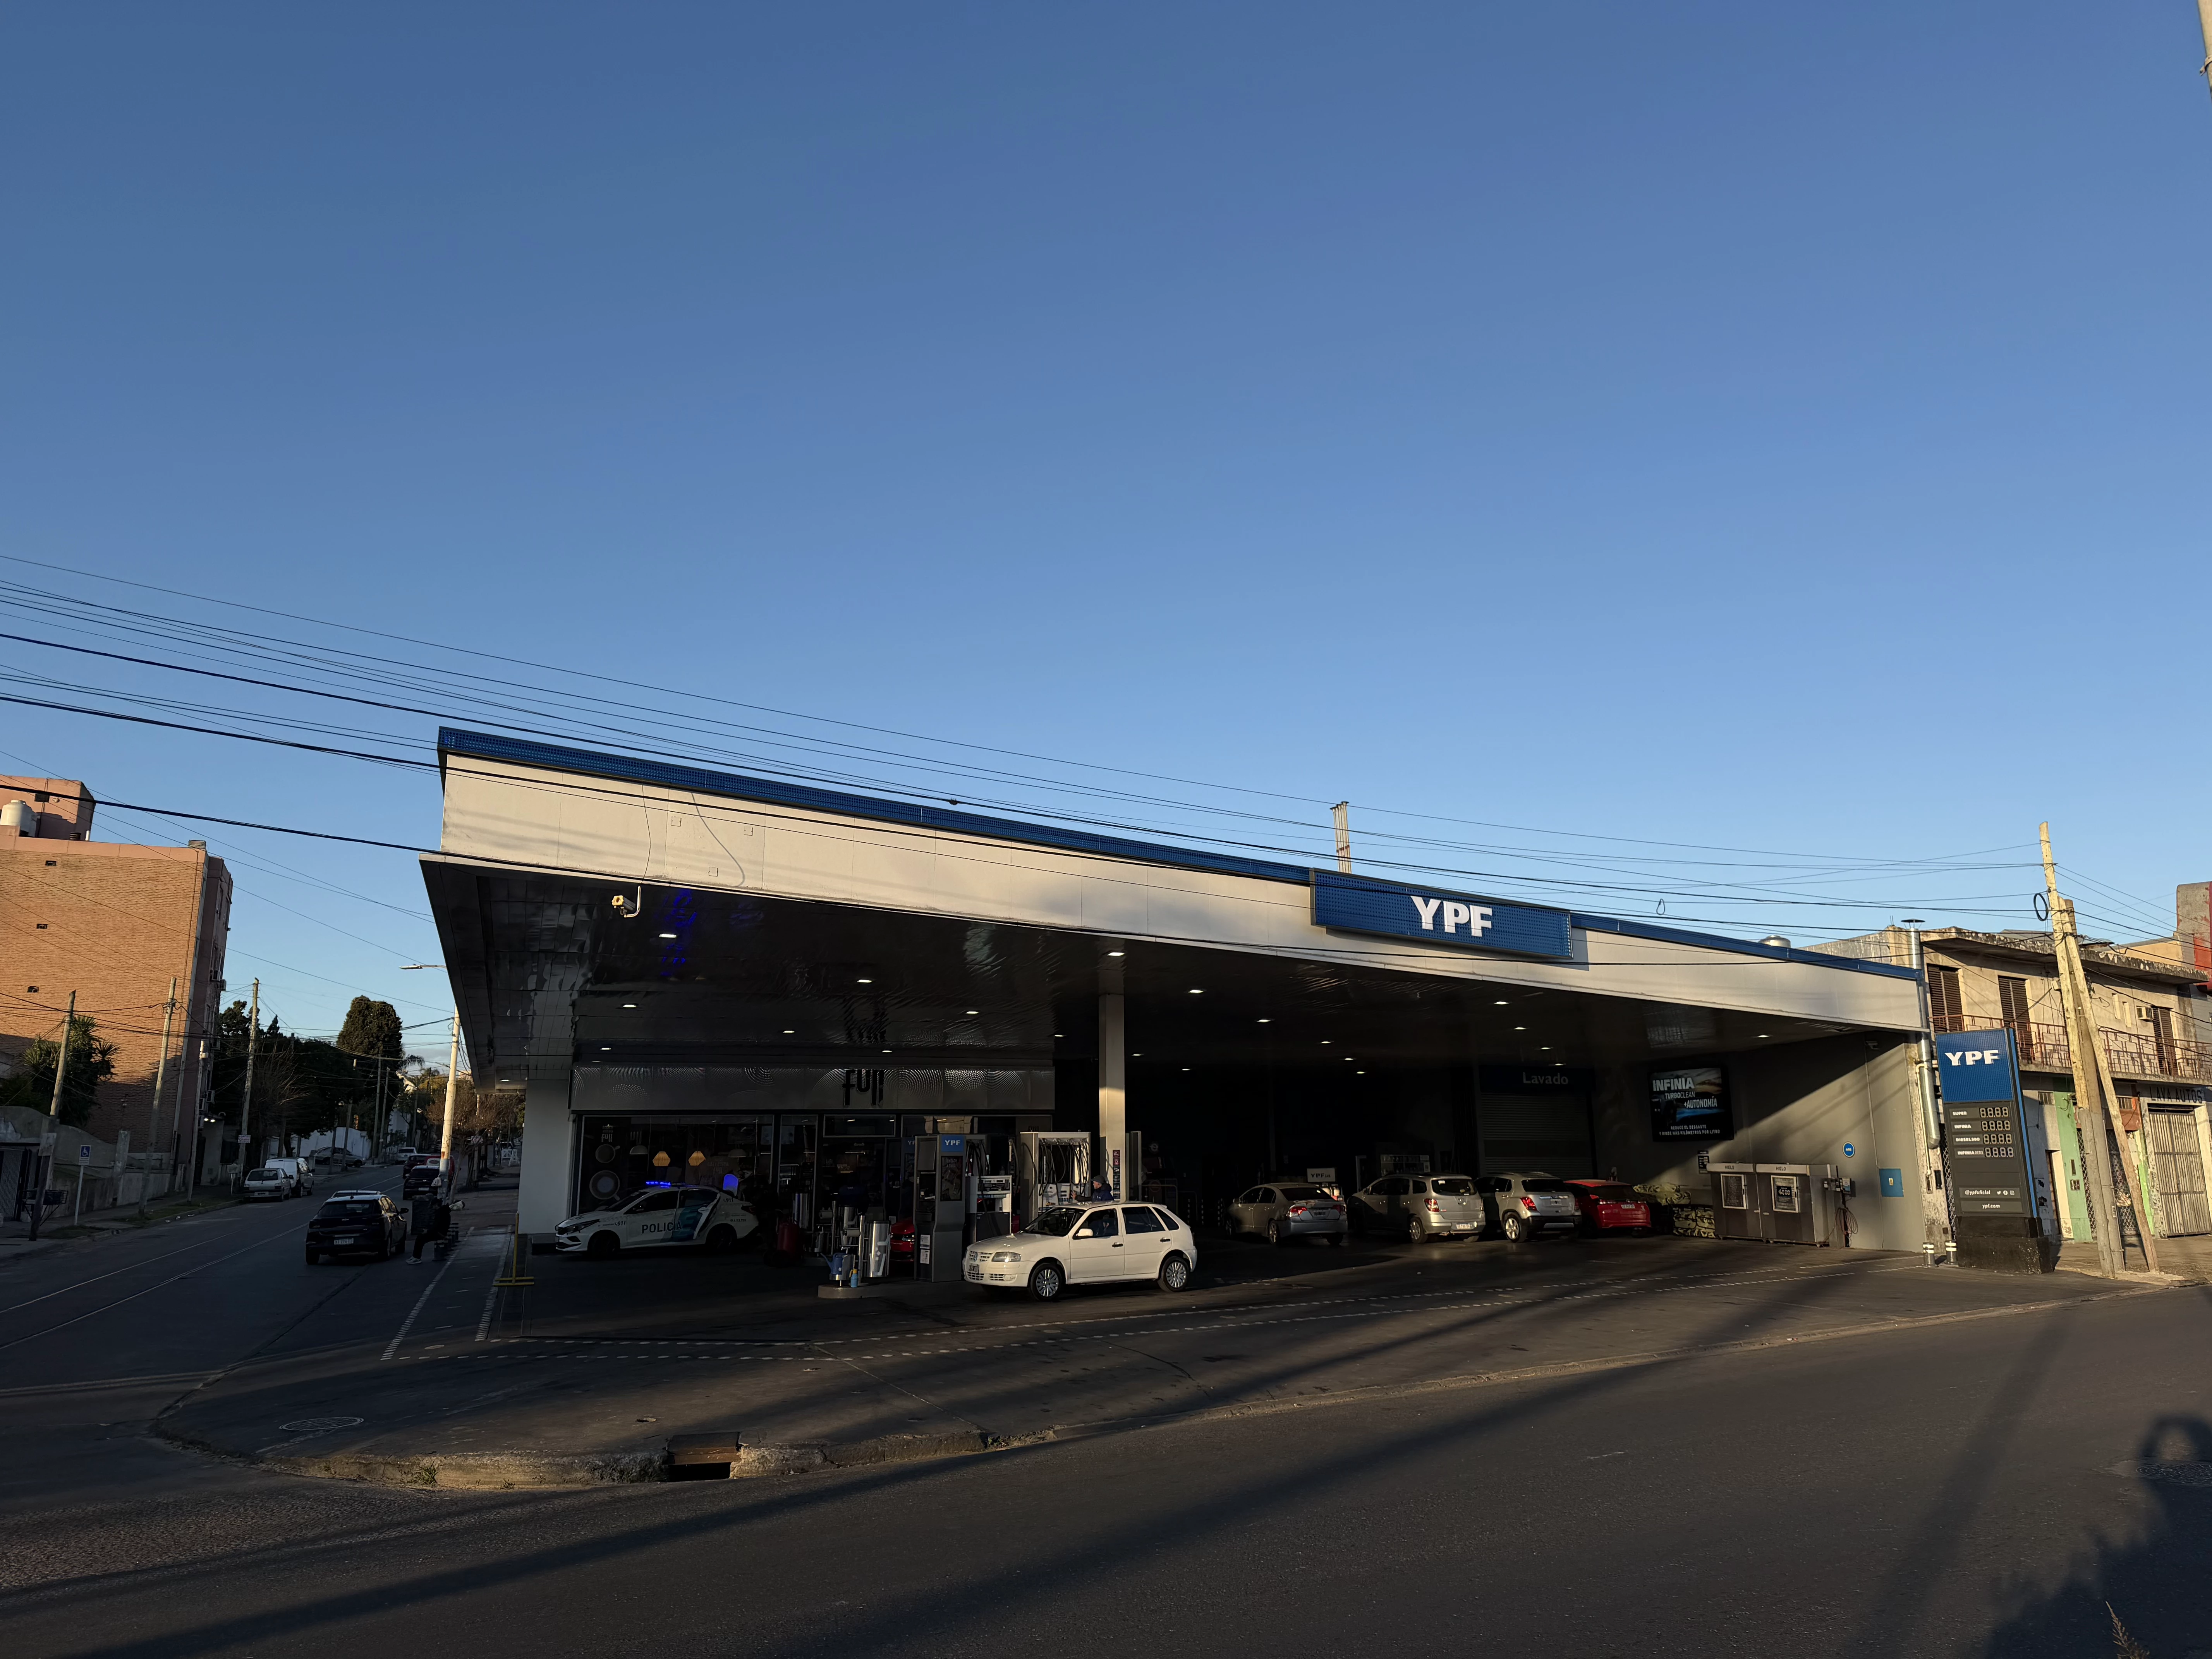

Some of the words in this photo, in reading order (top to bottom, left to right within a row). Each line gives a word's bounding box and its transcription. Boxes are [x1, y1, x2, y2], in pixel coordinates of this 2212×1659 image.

[1410, 896, 1492, 937] YPF
[1944, 1049, 1999, 1066] YPF
[1523, 1072, 1569, 1085] Lavado
[1652, 1077, 1695, 1091] INFINIA
[842, 1069, 884, 1106] full
[1665, 1091, 1695, 1099] TURBOCLEAN
[2150, 1086, 2172, 1101] LAVA
[2176, 1088, 2203, 1104] AUTOS
[1684, 1096, 1717, 1109] +AUTONOMÍA
